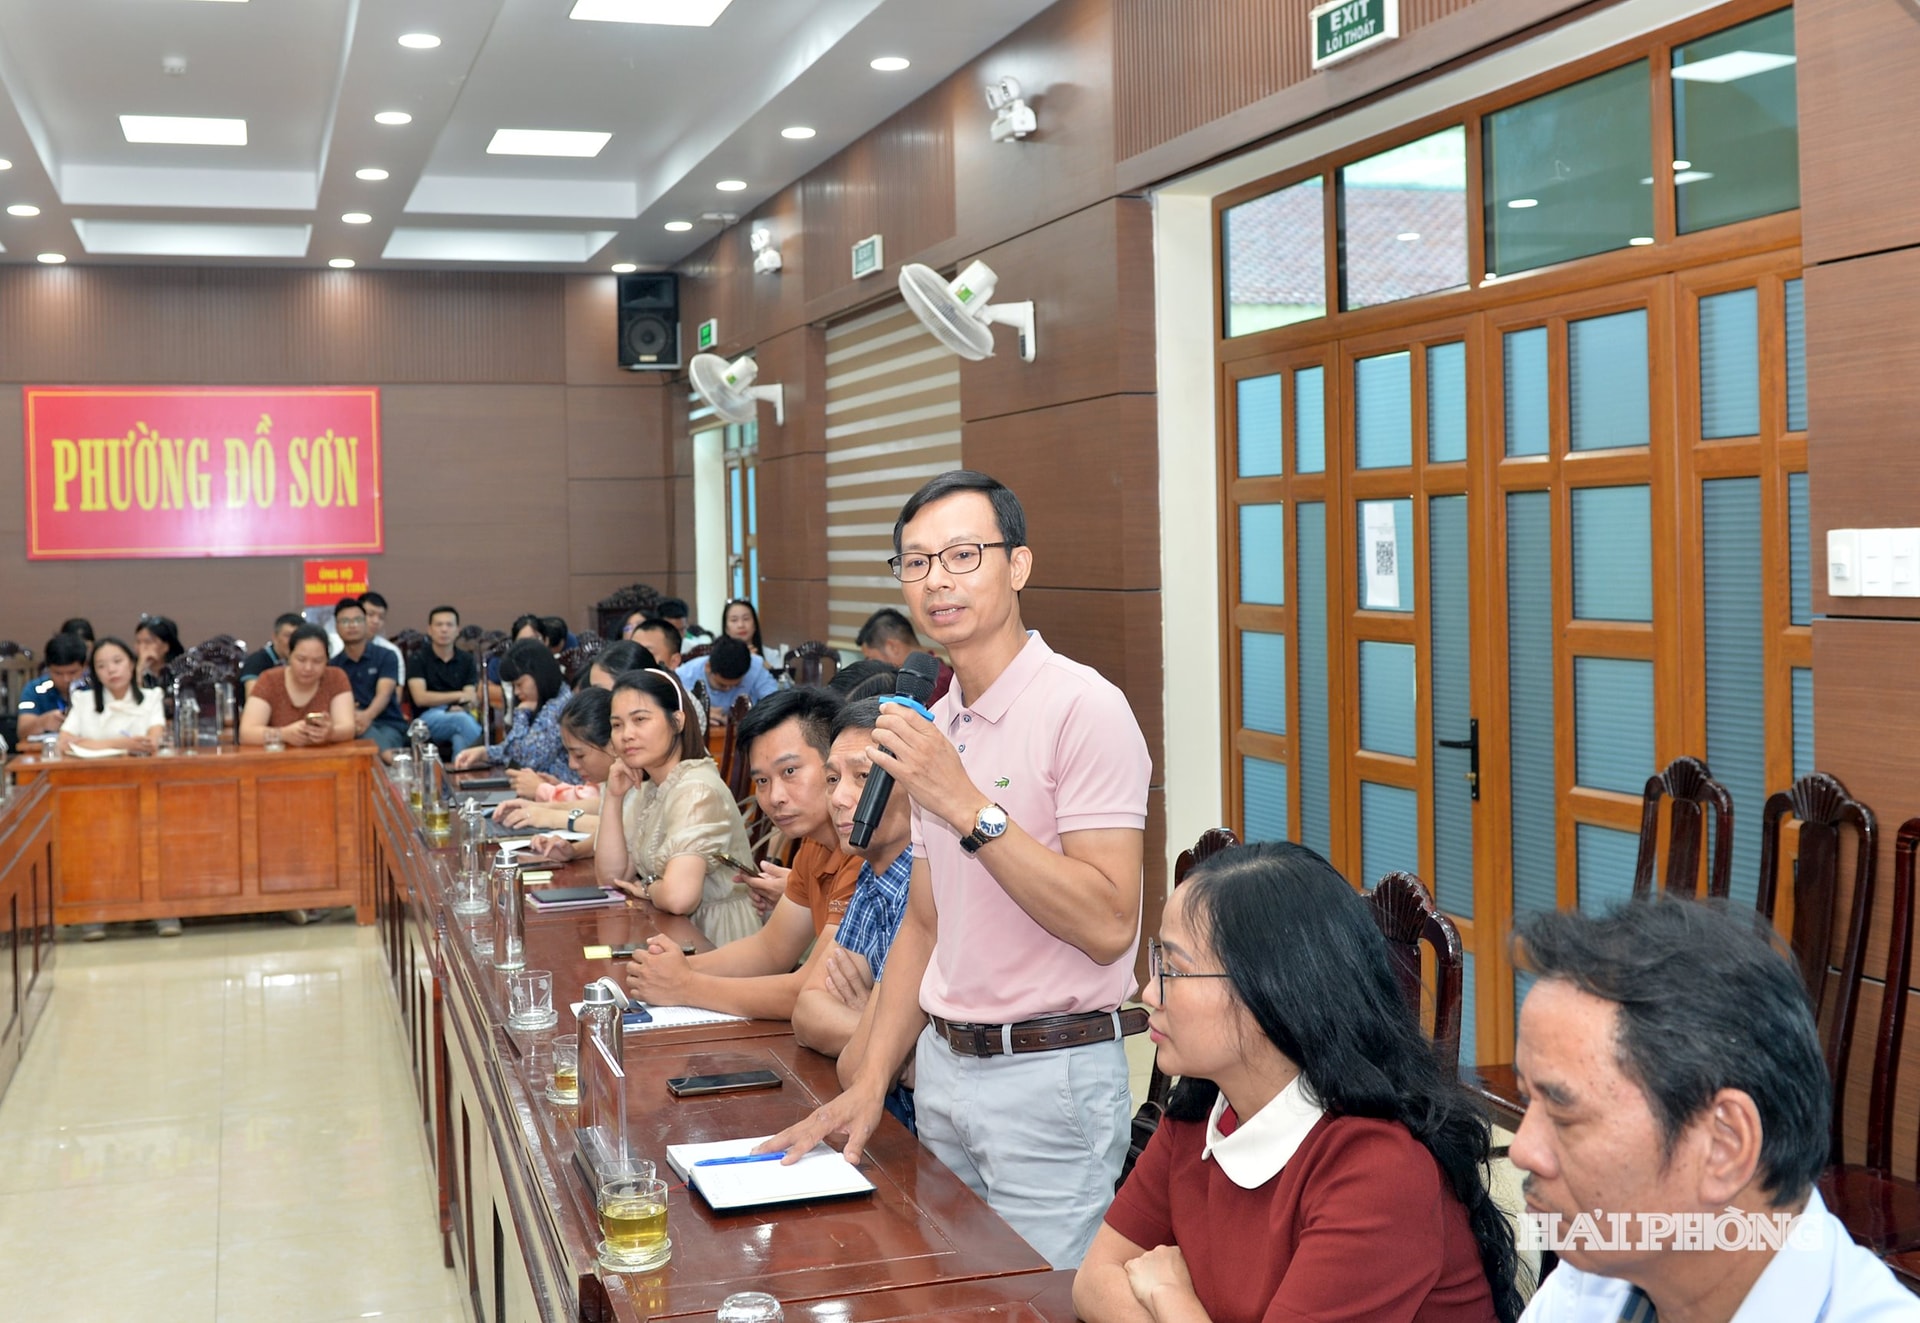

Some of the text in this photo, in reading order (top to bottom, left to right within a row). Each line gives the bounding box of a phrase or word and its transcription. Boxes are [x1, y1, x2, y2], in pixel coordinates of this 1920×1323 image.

[1330, 0, 1370, 32] EXIT
[1344, 19, 1376, 45] THOÁT
[51, 413, 359, 512] PHƯỜNG ĐỒ SƠN
